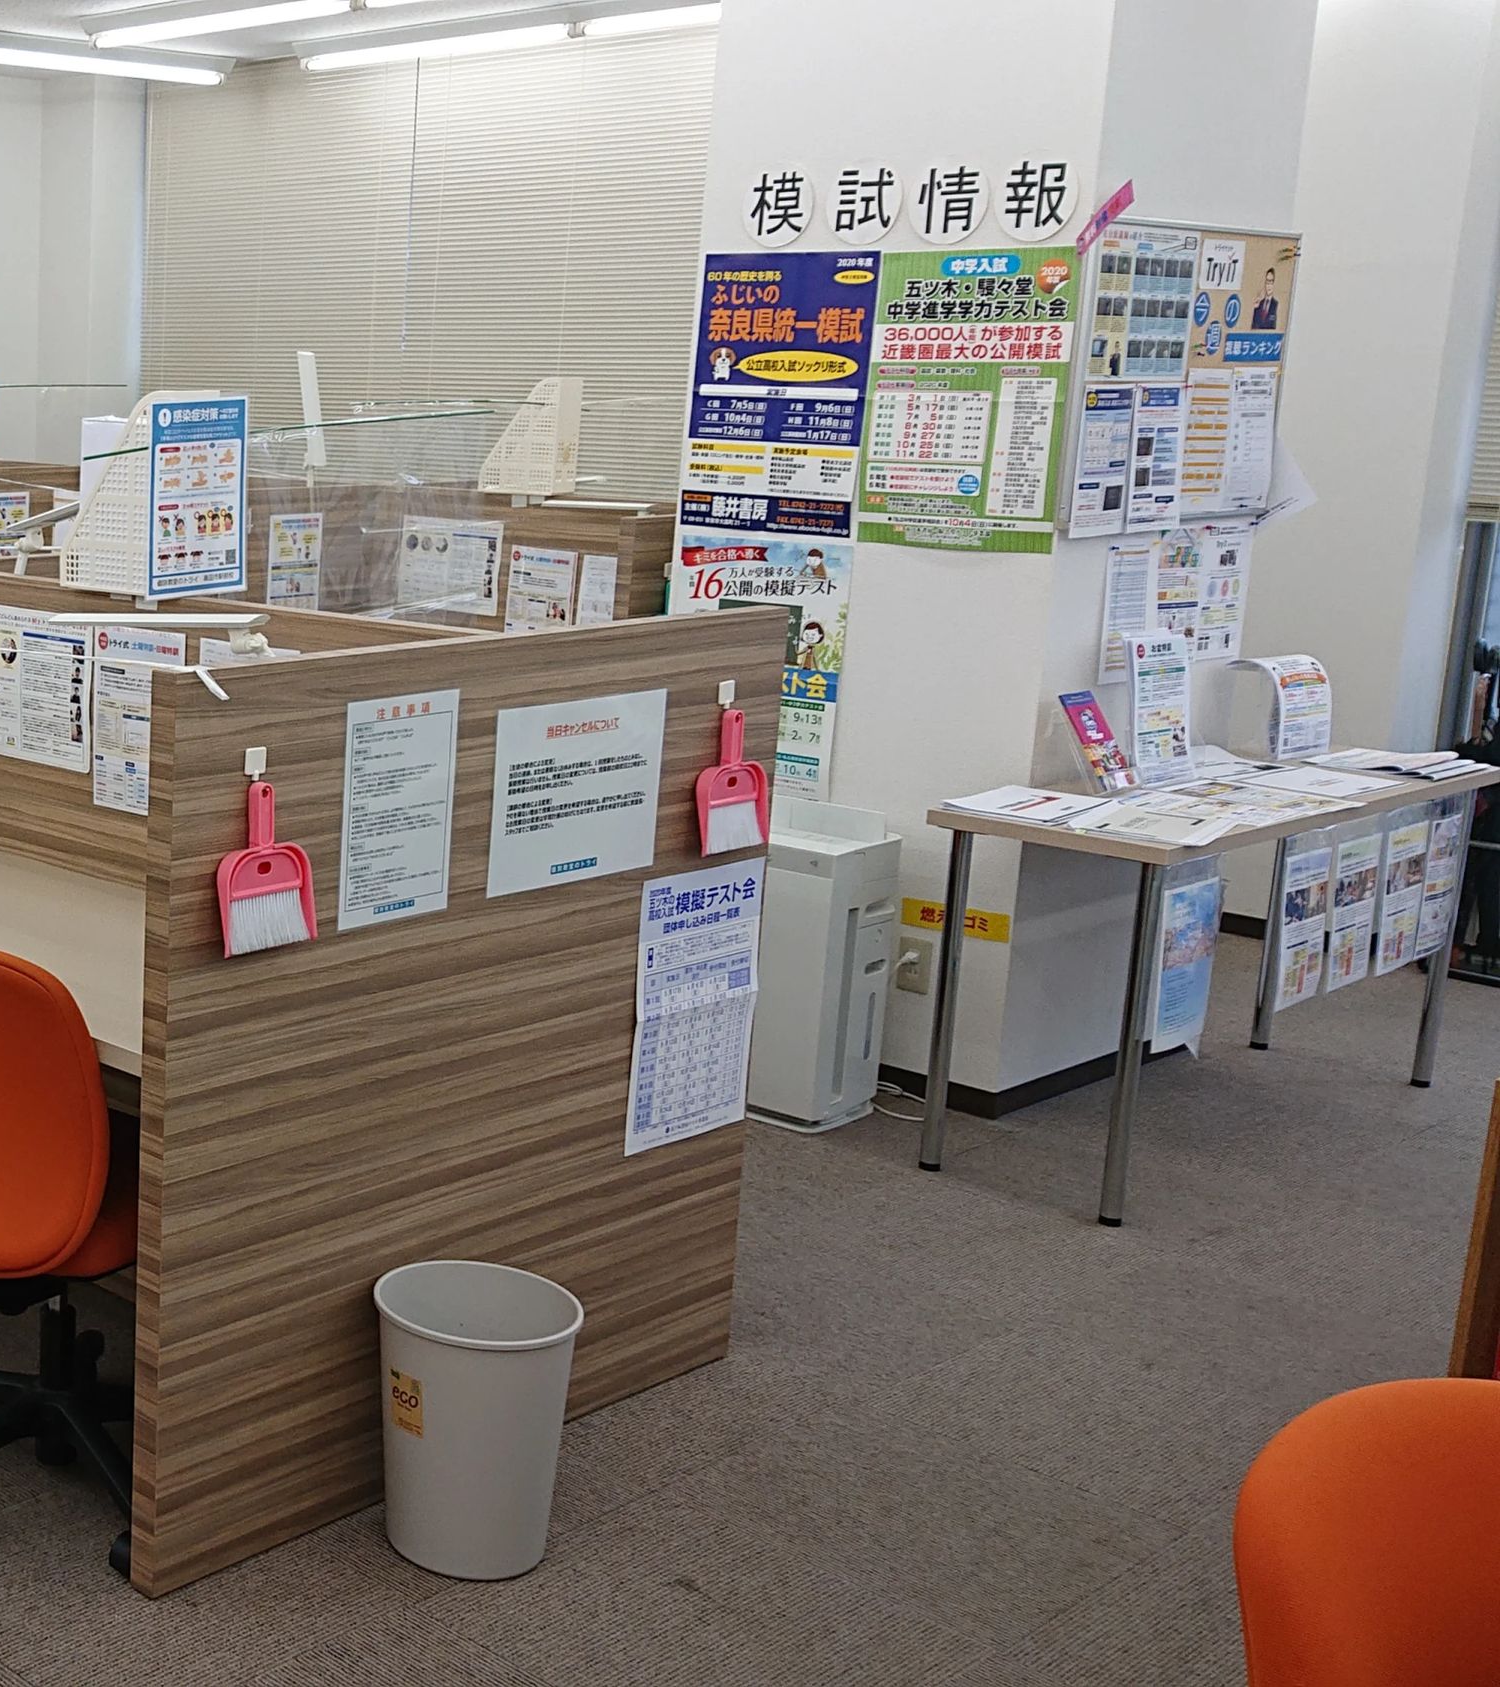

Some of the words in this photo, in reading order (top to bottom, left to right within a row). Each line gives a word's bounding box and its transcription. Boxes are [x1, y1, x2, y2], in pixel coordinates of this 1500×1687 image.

[751, 160, 1068, 237] 模試情報
[951, 258, 1008, 273] 中学入試
[711, 284, 780, 304] ふじいの
[905, 277, 1033, 298] 五ツ木・駸々堂
[887, 298, 1068, 320] 中学進学学力テスト会
[708, 307, 866, 344] 奈良県統一模試
[981, 325, 1063, 341] が参加する
[881, 343, 1062, 360] 近畿圏最大の公開模試
[746, 359, 847, 374] 公立高校入試ソックリ形式
[173, 408, 219, 424] 感染症対策
[712, 496, 769, 520] 藤井書房
[690, 567, 726, 600] 16
[729, 566, 796, 579] 万人が受験する
[724, 579, 838, 597] 公開の模擬テスト
[546, 716, 620, 739] 当日キャンセルについて
[676, 877, 756, 915] 模擬テスト会
[392, 1385, 419, 1409] eco
